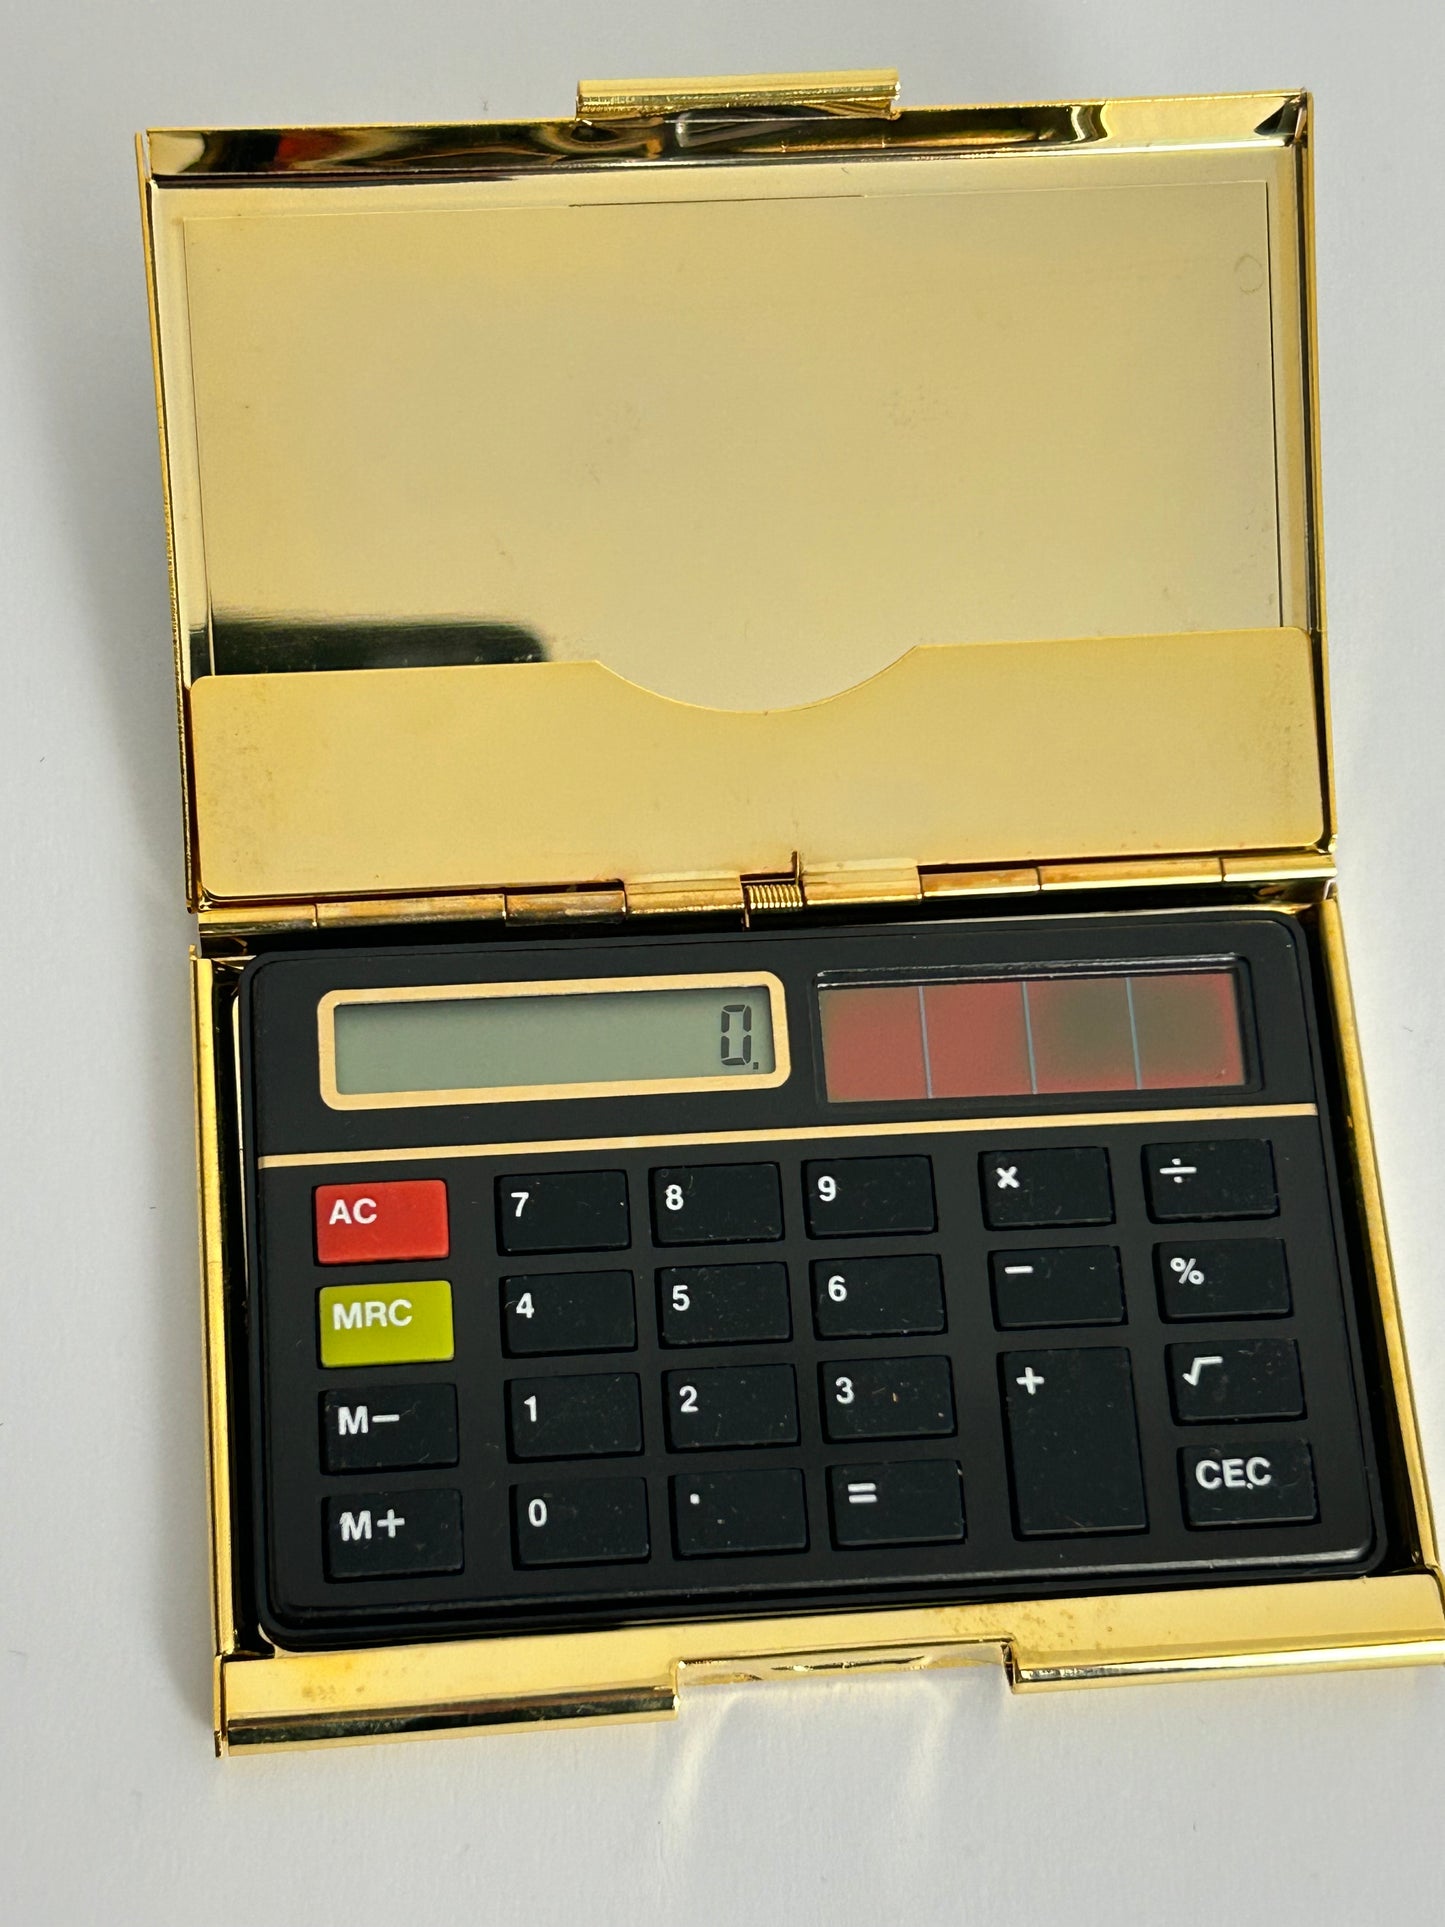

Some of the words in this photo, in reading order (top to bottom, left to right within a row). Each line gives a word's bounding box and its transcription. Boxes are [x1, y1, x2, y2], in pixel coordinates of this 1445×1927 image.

[665, 1184, 684, 1211] 8
[817, 1175, 837, 1202] 9
[328, 1198, 378, 1225] AC
[511, 1192, 530, 1217] 7
[1170, 1257, 1205, 1285] %
[672, 1284, 691, 1312] 5
[828, 1275, 848, 1302] 6
[332, 1299, 412, 1330] MRC
[515, 1292, 535, 1319] 4
[835, 1376, 855, 1405] 3
[1016, 1366, 1045, 1395] +
[523, 1395, 538, 1422] 1
[679, 1385, 699, 1413] 2
[847, 1482, 877, 1504] =
[339, 1509, 406, 1541] M+
[528, 1498, 548, 1527] 0
